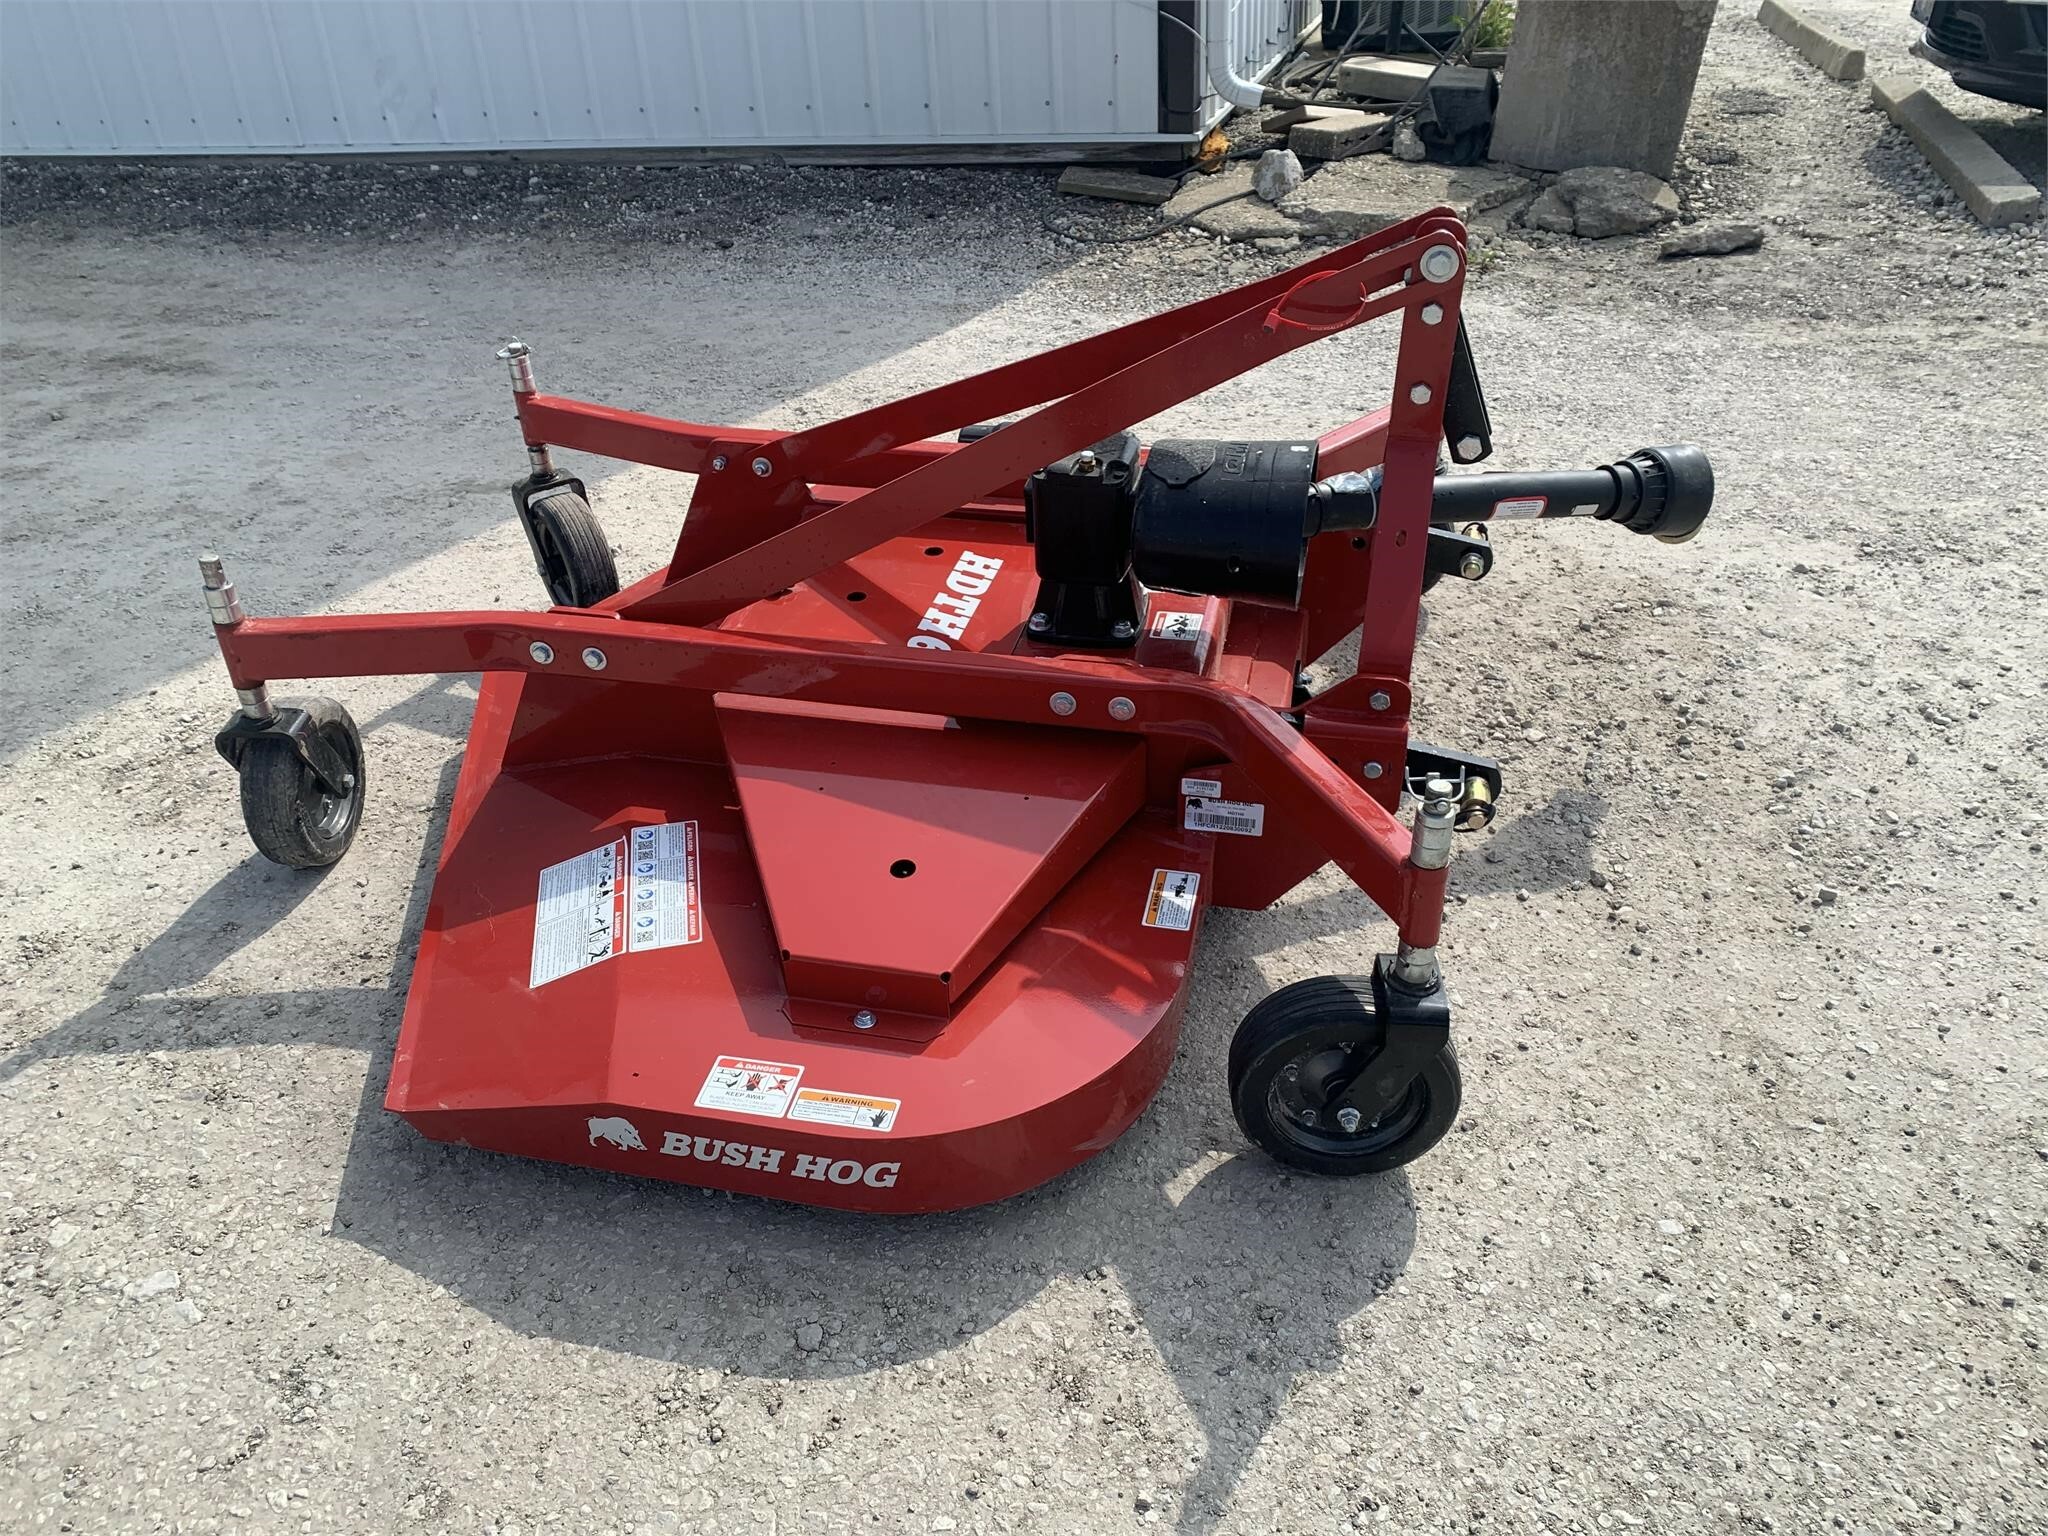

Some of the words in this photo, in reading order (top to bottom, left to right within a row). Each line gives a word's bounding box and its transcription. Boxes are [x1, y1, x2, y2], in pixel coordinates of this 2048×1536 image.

[744, 1063, 782, 1073] DANGER
[831, 1097, 873, 1107] WARNING
[660, 1131, 785, 1173] BUSH
[791, 1154, 901, 1188] HOG
